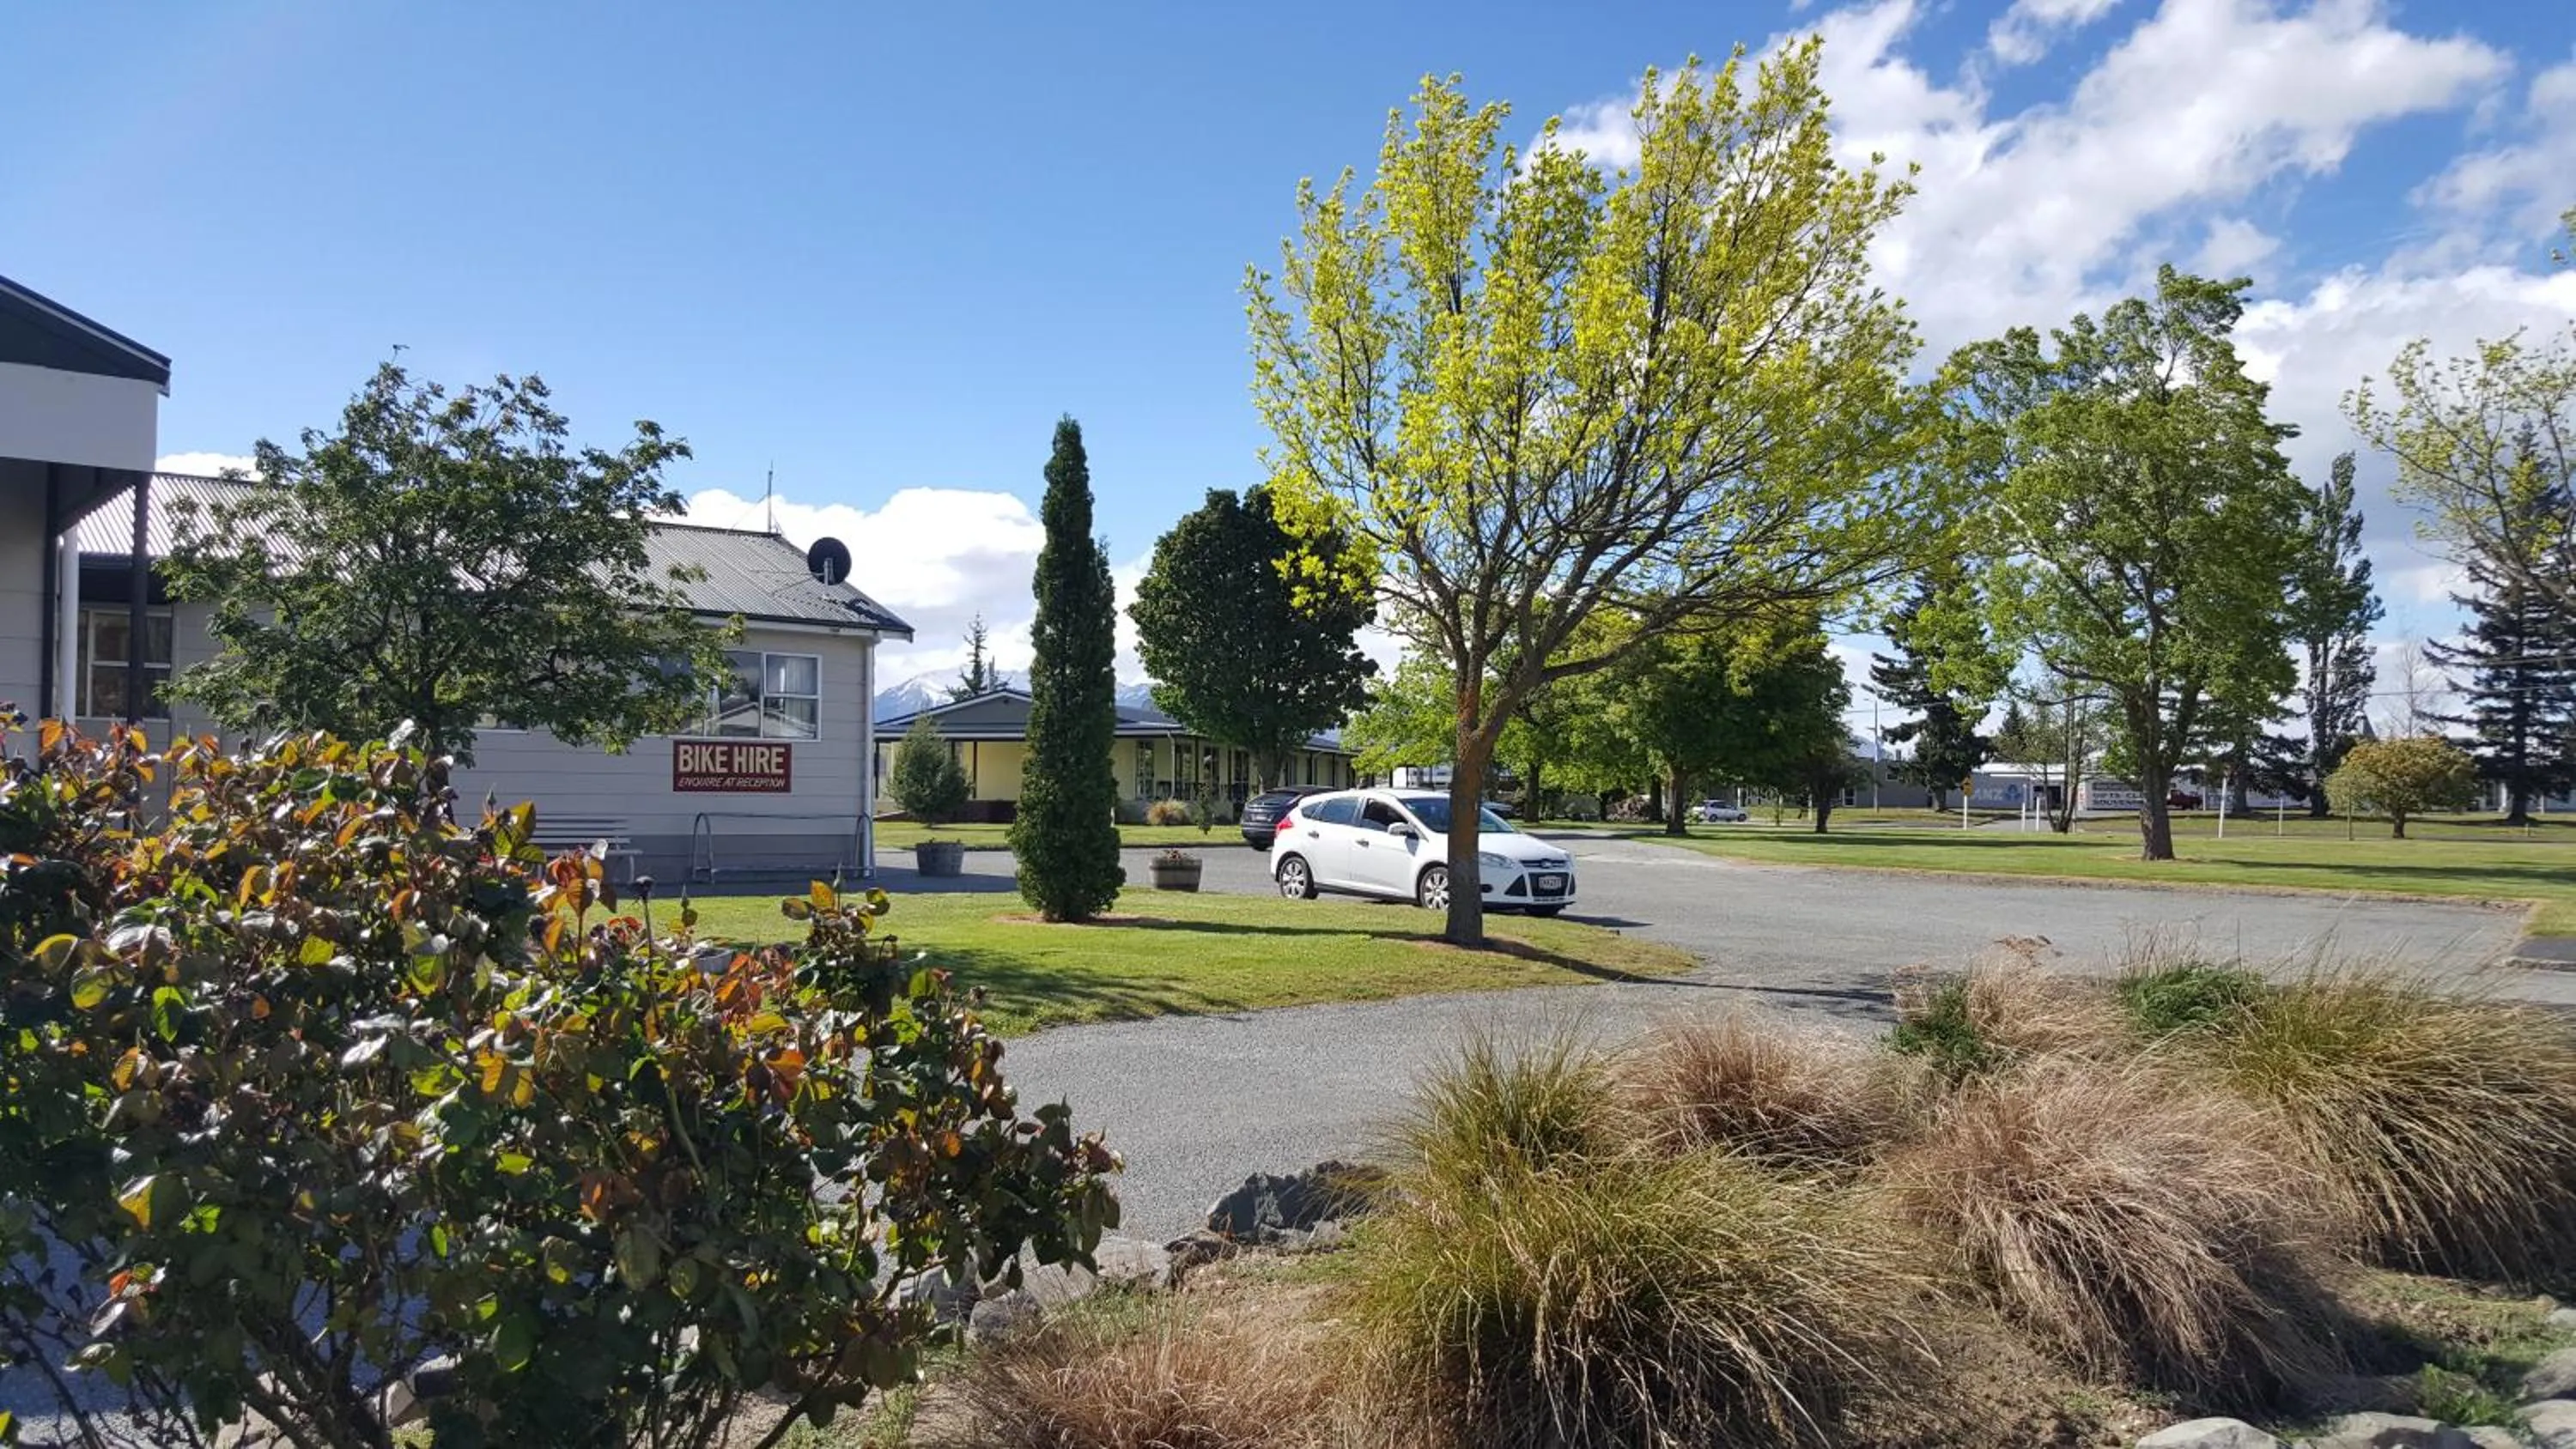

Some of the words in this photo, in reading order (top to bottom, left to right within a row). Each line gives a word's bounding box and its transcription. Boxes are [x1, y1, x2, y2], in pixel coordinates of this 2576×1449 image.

[678, 744, 728, 773] BIKE
[732, 745, 785, 774] HIRE
[678, 777, 723, 787] ENQUIRE
[723, 777, 736, 787] AT
[737, 777, 785, 787] RECEPTION
